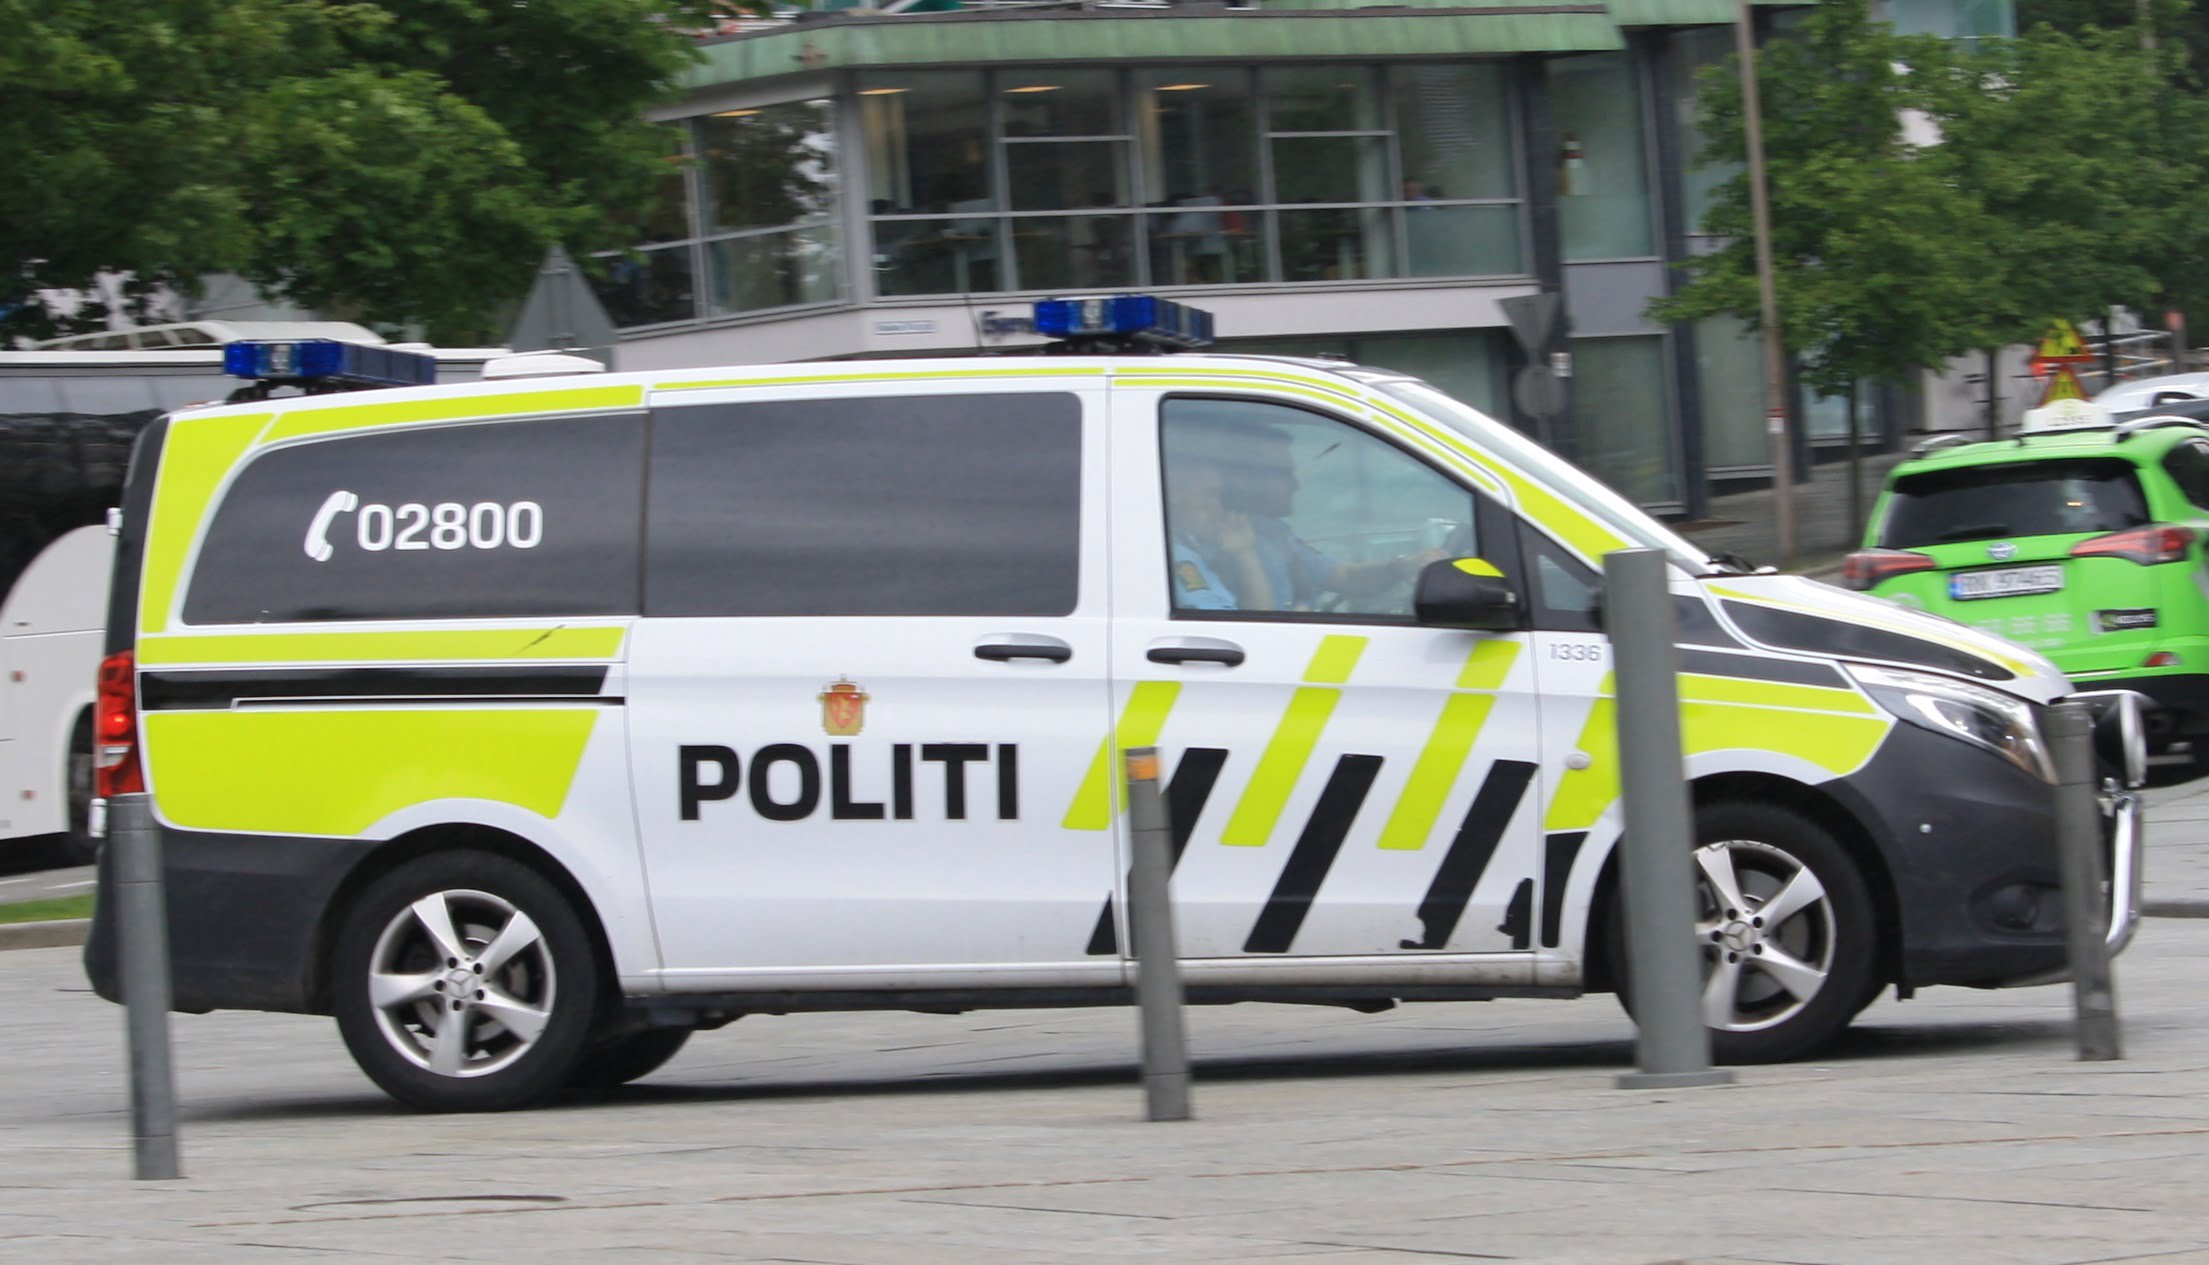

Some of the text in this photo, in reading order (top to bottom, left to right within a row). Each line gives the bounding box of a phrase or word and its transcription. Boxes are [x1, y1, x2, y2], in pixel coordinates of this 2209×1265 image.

[357, 502, 544, 551] 02800
[1549, 643, 1602, 661] 1336
[679, 743, 1018, 821] POLITI
